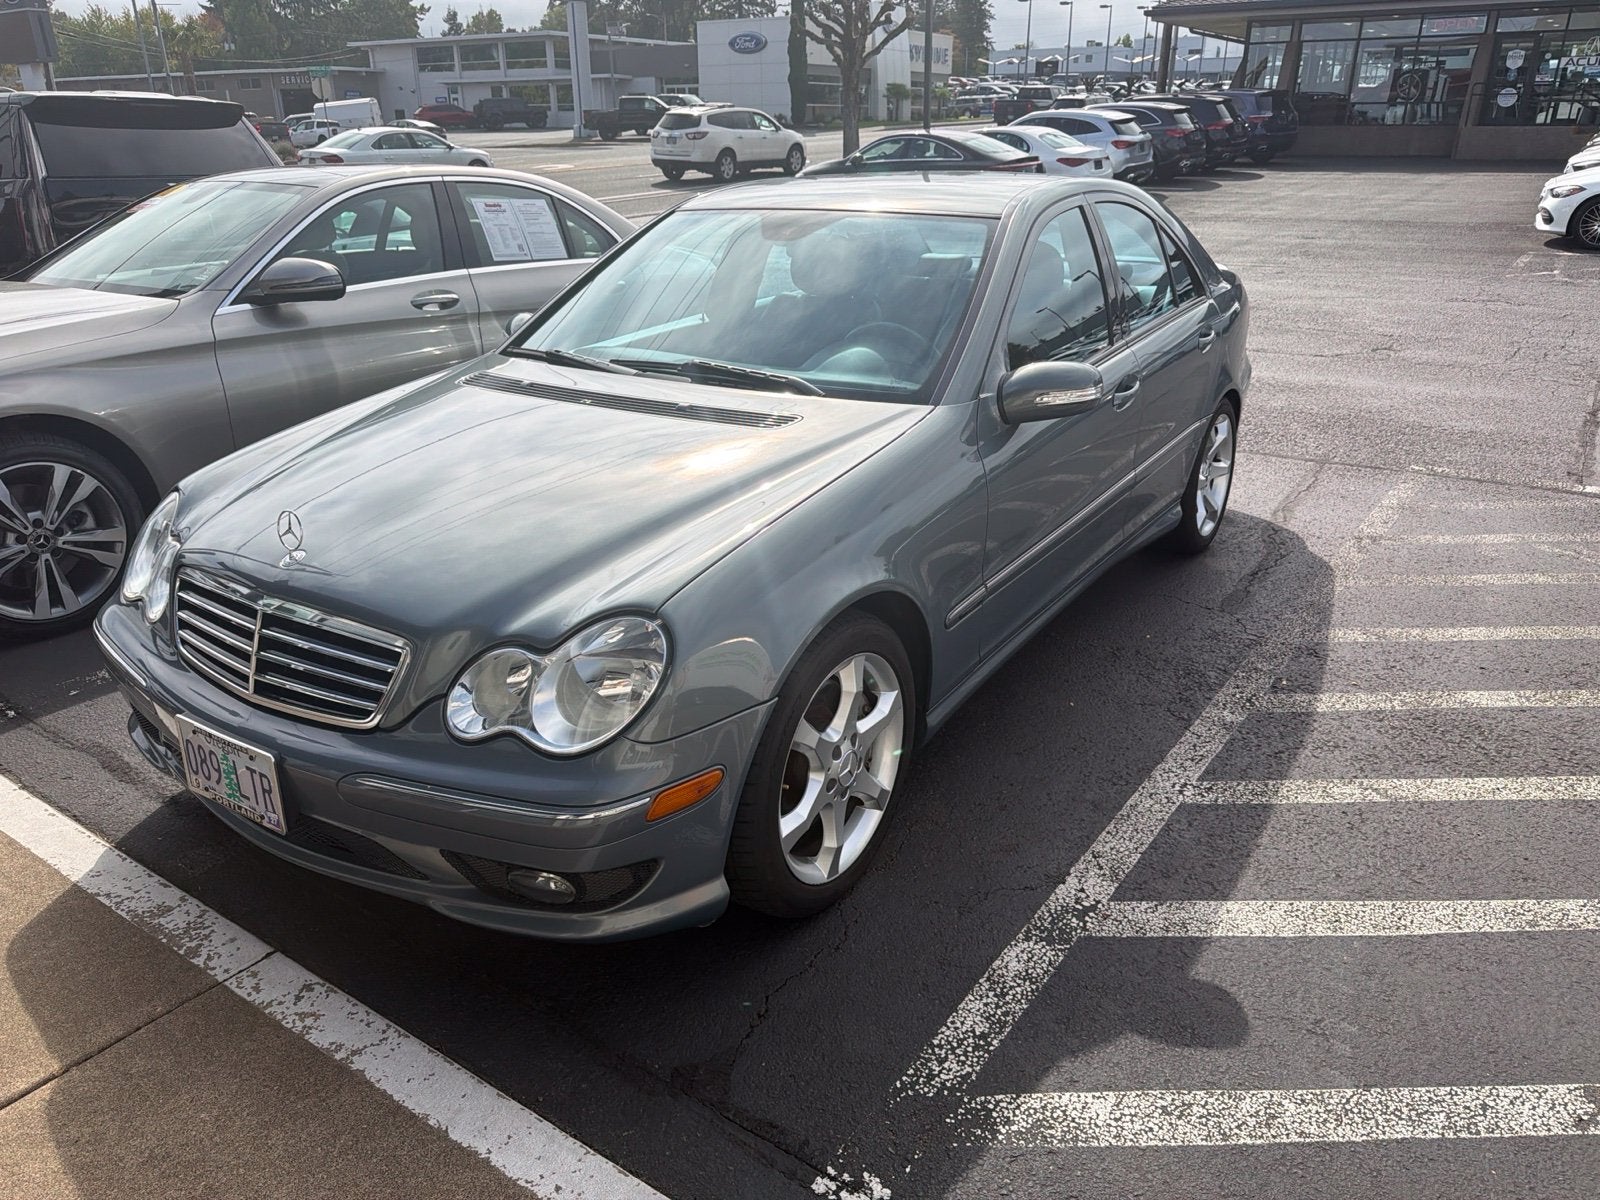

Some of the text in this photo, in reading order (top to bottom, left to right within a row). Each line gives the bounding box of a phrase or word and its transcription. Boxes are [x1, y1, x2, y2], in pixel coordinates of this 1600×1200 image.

[1564, 57, 1600, 66] ACU
[185, 739, 222, 785] 089
[232, 760, 277, 814] LTR
[210, 793, 263, 824] PORTLAND
